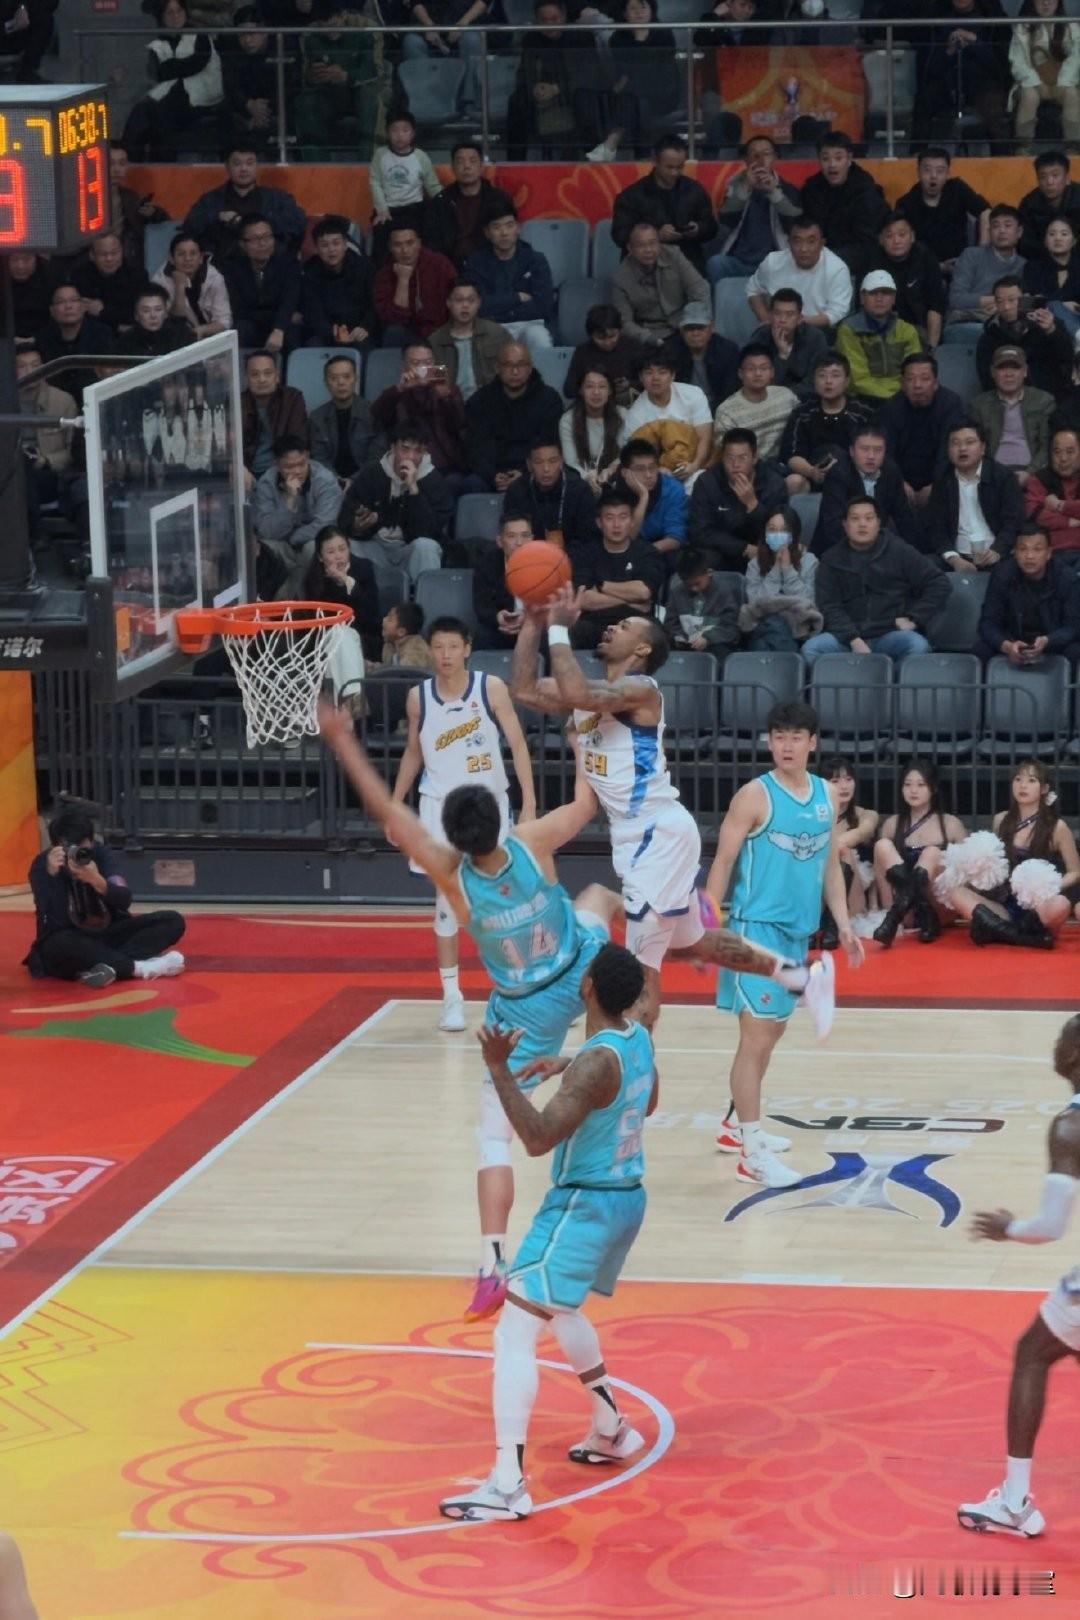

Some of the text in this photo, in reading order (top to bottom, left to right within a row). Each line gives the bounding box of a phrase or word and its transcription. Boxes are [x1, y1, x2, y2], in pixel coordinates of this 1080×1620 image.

[77, 146, 104, 232] 13
[466, 752, 492, 773] 25
[501, 922, 557, 970] 14
[766, 1114, 1006, 1134] CBA
